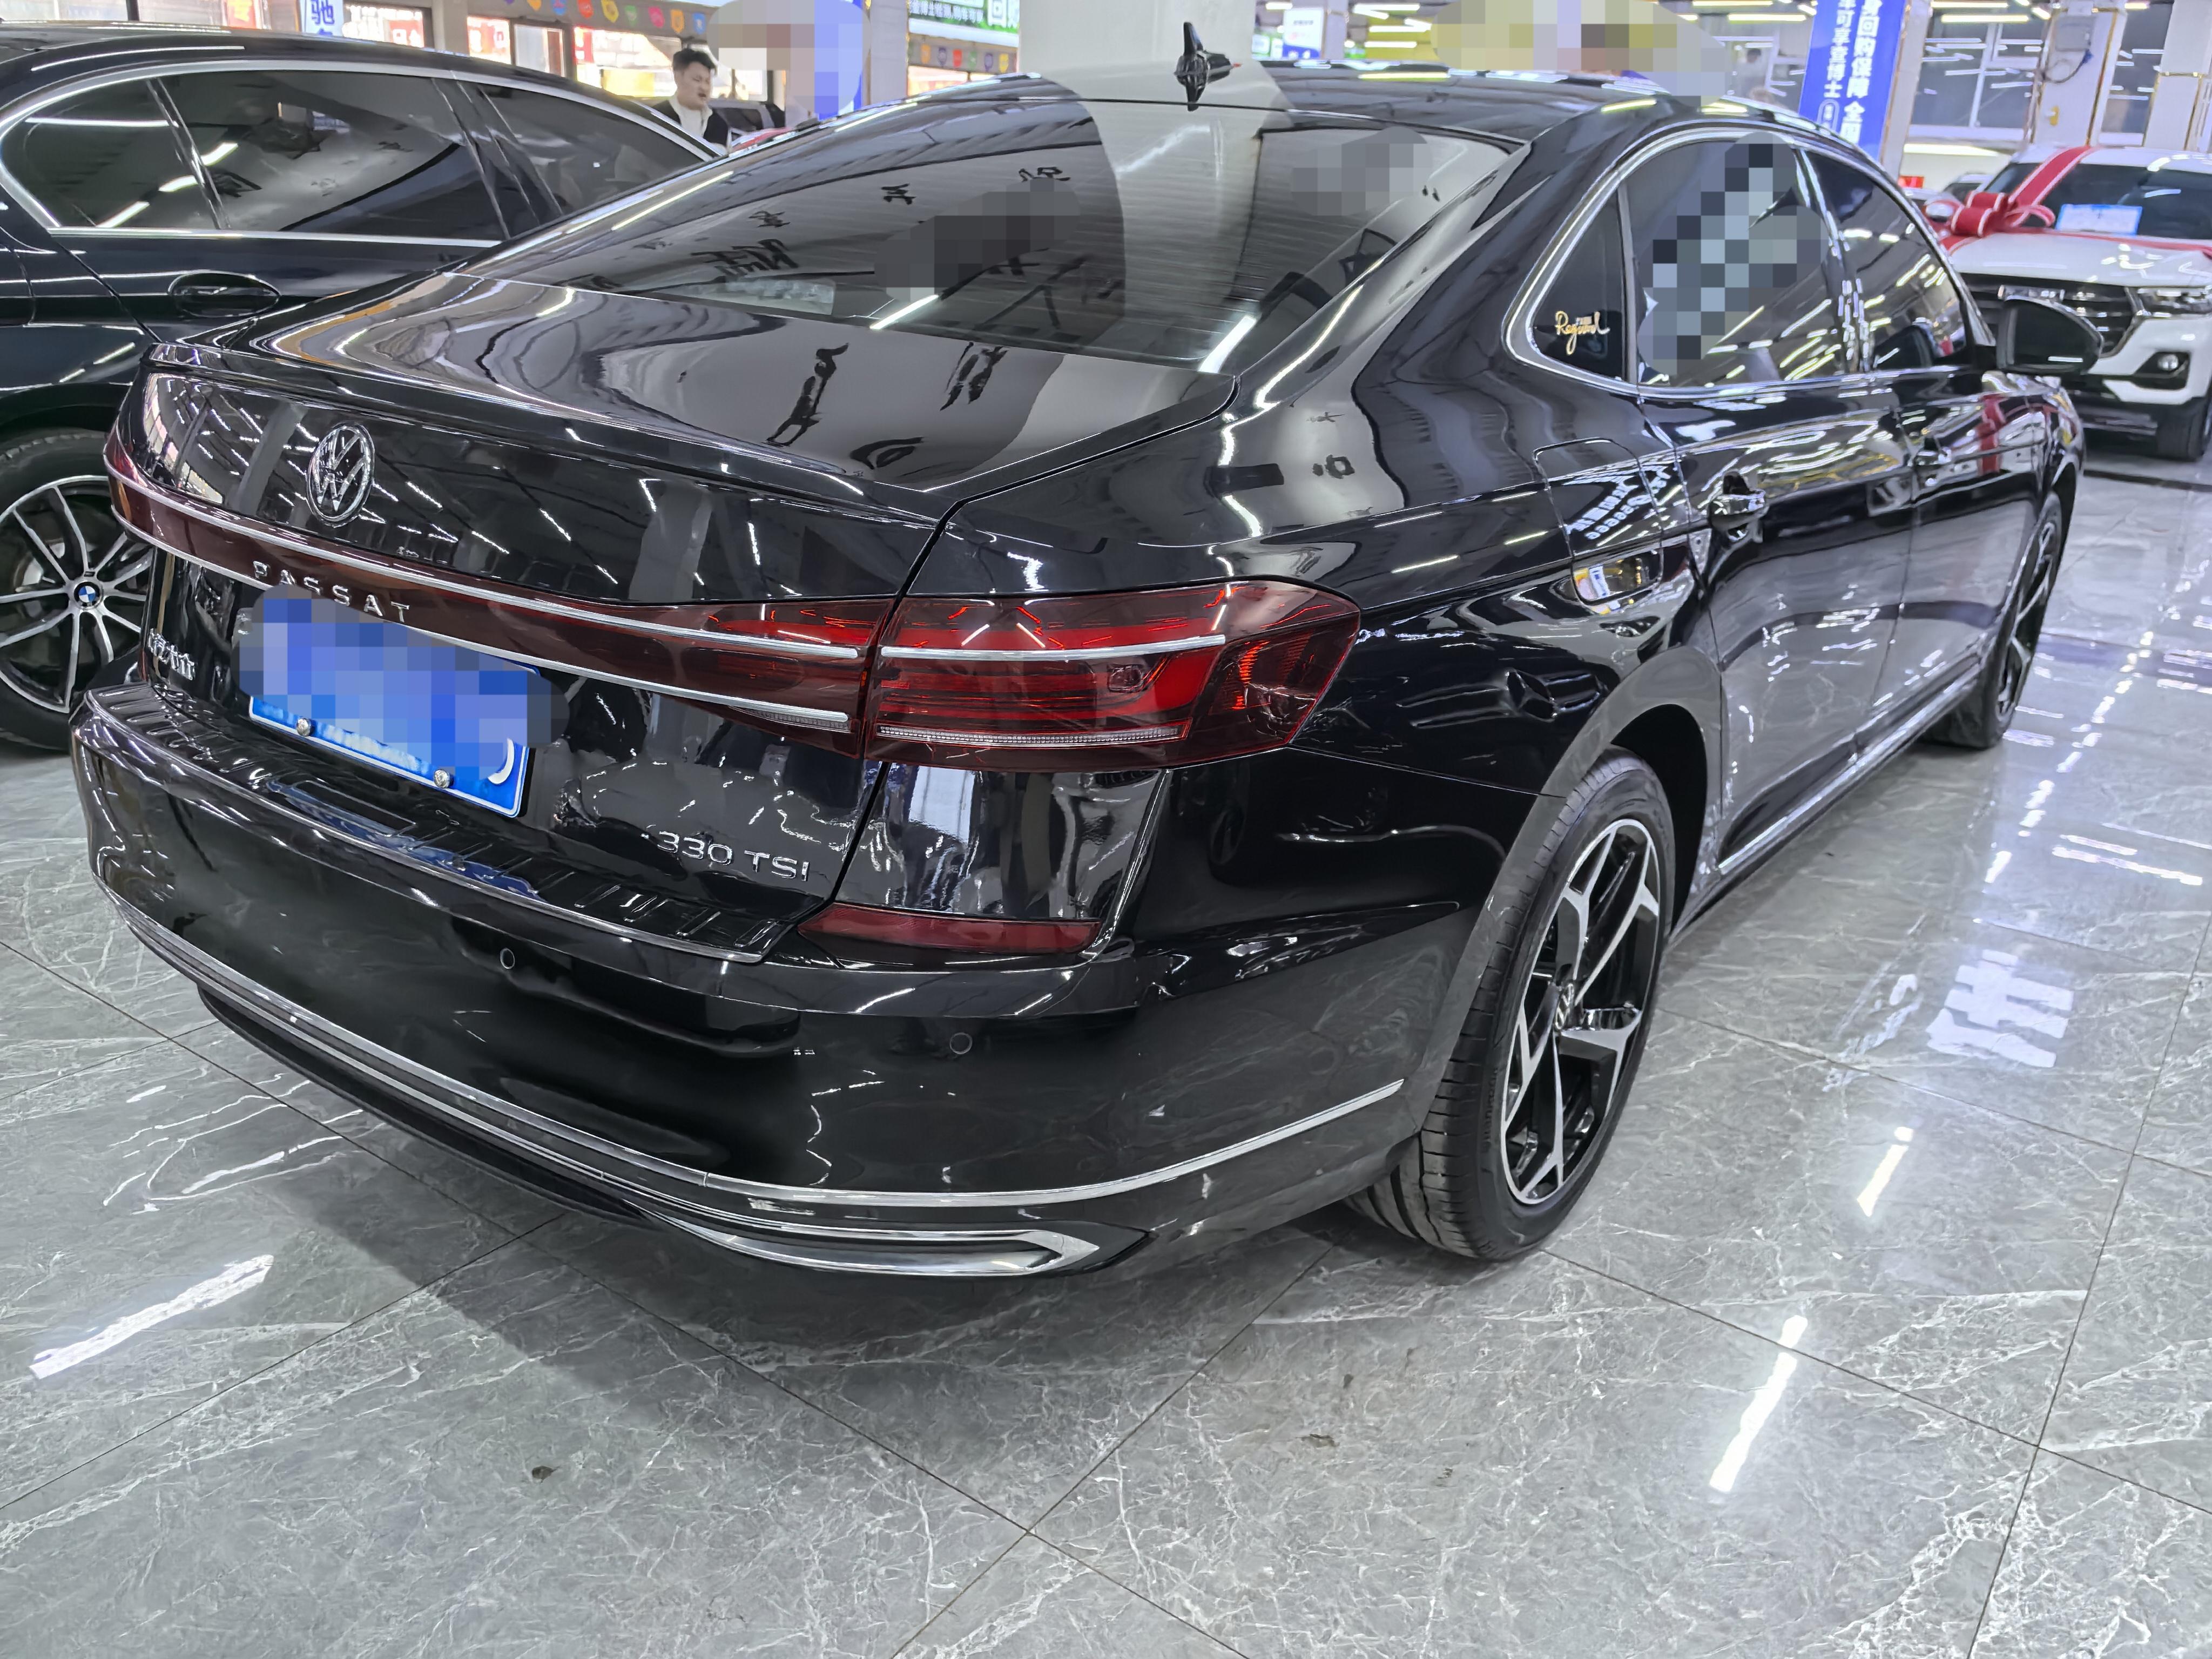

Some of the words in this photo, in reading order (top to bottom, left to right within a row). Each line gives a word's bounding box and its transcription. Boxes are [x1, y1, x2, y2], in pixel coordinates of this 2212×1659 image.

[253, 561, 410, 623] PASSAT
[657, 831, 733, 865] 330
[744, 849, 810, 882] TSI
